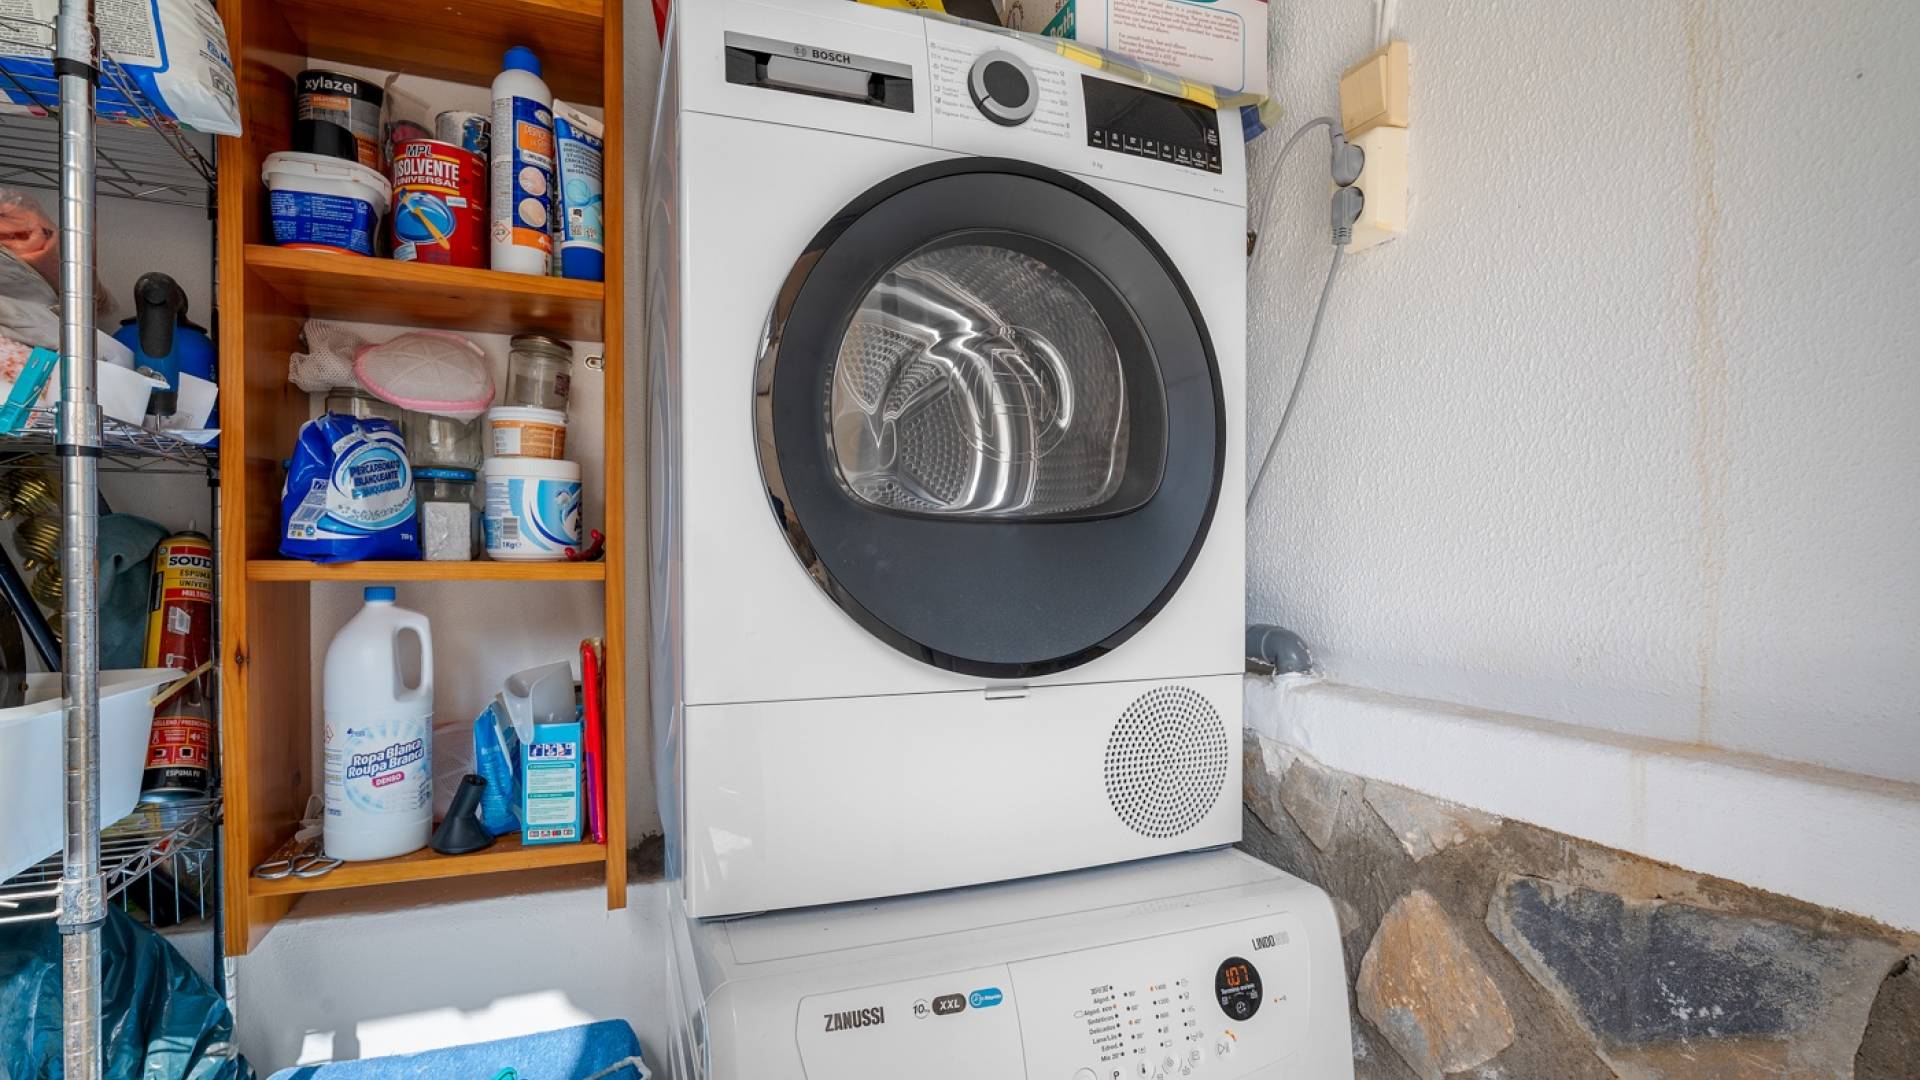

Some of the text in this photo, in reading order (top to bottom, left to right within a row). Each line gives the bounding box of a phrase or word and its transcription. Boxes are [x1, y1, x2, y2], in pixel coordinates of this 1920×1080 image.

[812, 49, 851, 65] BOSCH
[305, 76, 357, 95] xylazel
[398, 176, 460, 189] UNIVERSAL
[353, 739, 423, 769] Ropa Blanca
[347, 749, 424, 779] Roupa Branca
[374, 773, 402, 787] DENSO
[938, 998, 961, 1011] XXL
[824, 1006, 885, 1033] ZANUSSI
